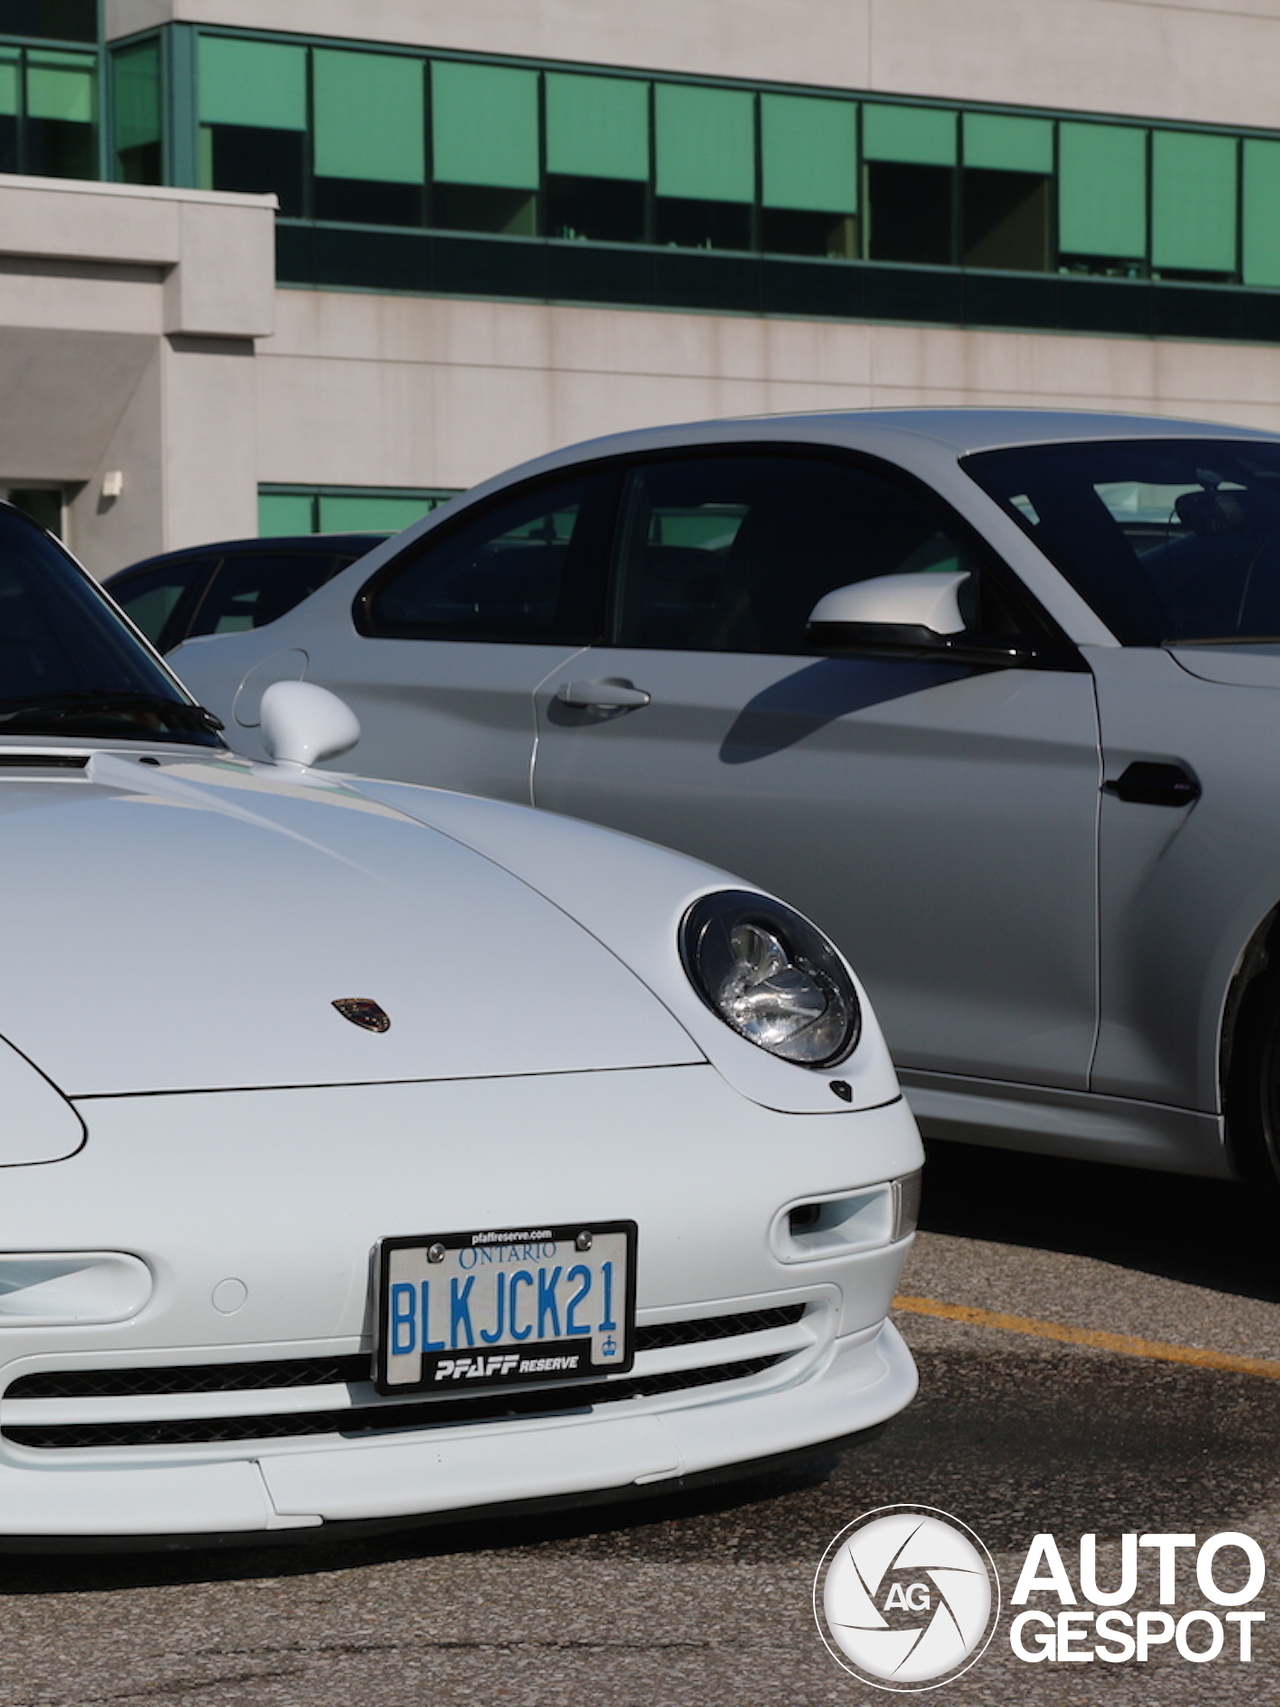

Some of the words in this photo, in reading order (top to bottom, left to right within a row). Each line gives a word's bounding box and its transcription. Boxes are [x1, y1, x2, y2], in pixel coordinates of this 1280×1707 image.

[471, 1229, 553, 1246] pfaffreserve.com
[458, 1241, 557, 1270] ONTARIO
[391, 1261, 617, 1356] BLKJCK21
[434, 1354, 520, 1381] PFAFF
[519, 1355, 580, 1374] RESERVE
